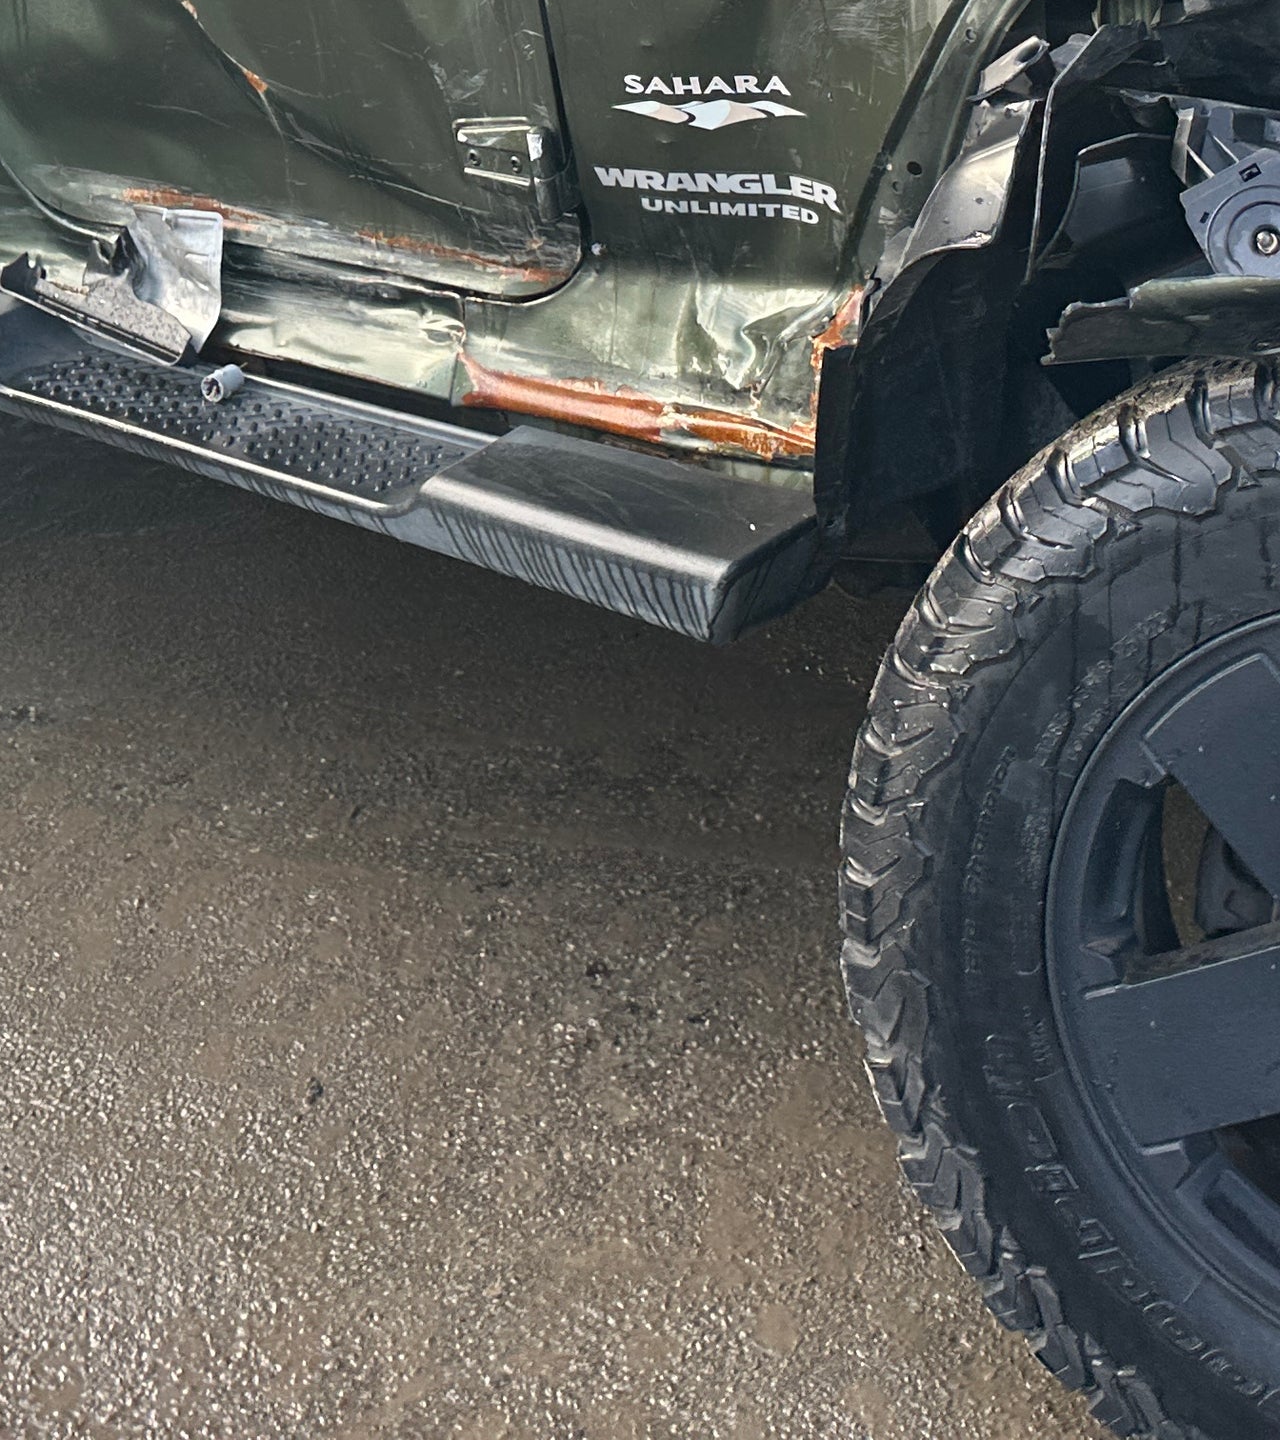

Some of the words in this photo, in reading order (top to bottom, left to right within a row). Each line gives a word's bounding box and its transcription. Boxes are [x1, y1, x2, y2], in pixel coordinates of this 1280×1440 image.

[623, 74, 791, 96] SAHARA
[593, 166, 842, 214] WRANGLER
[641, 197, 819, 225] UNLIMITED
